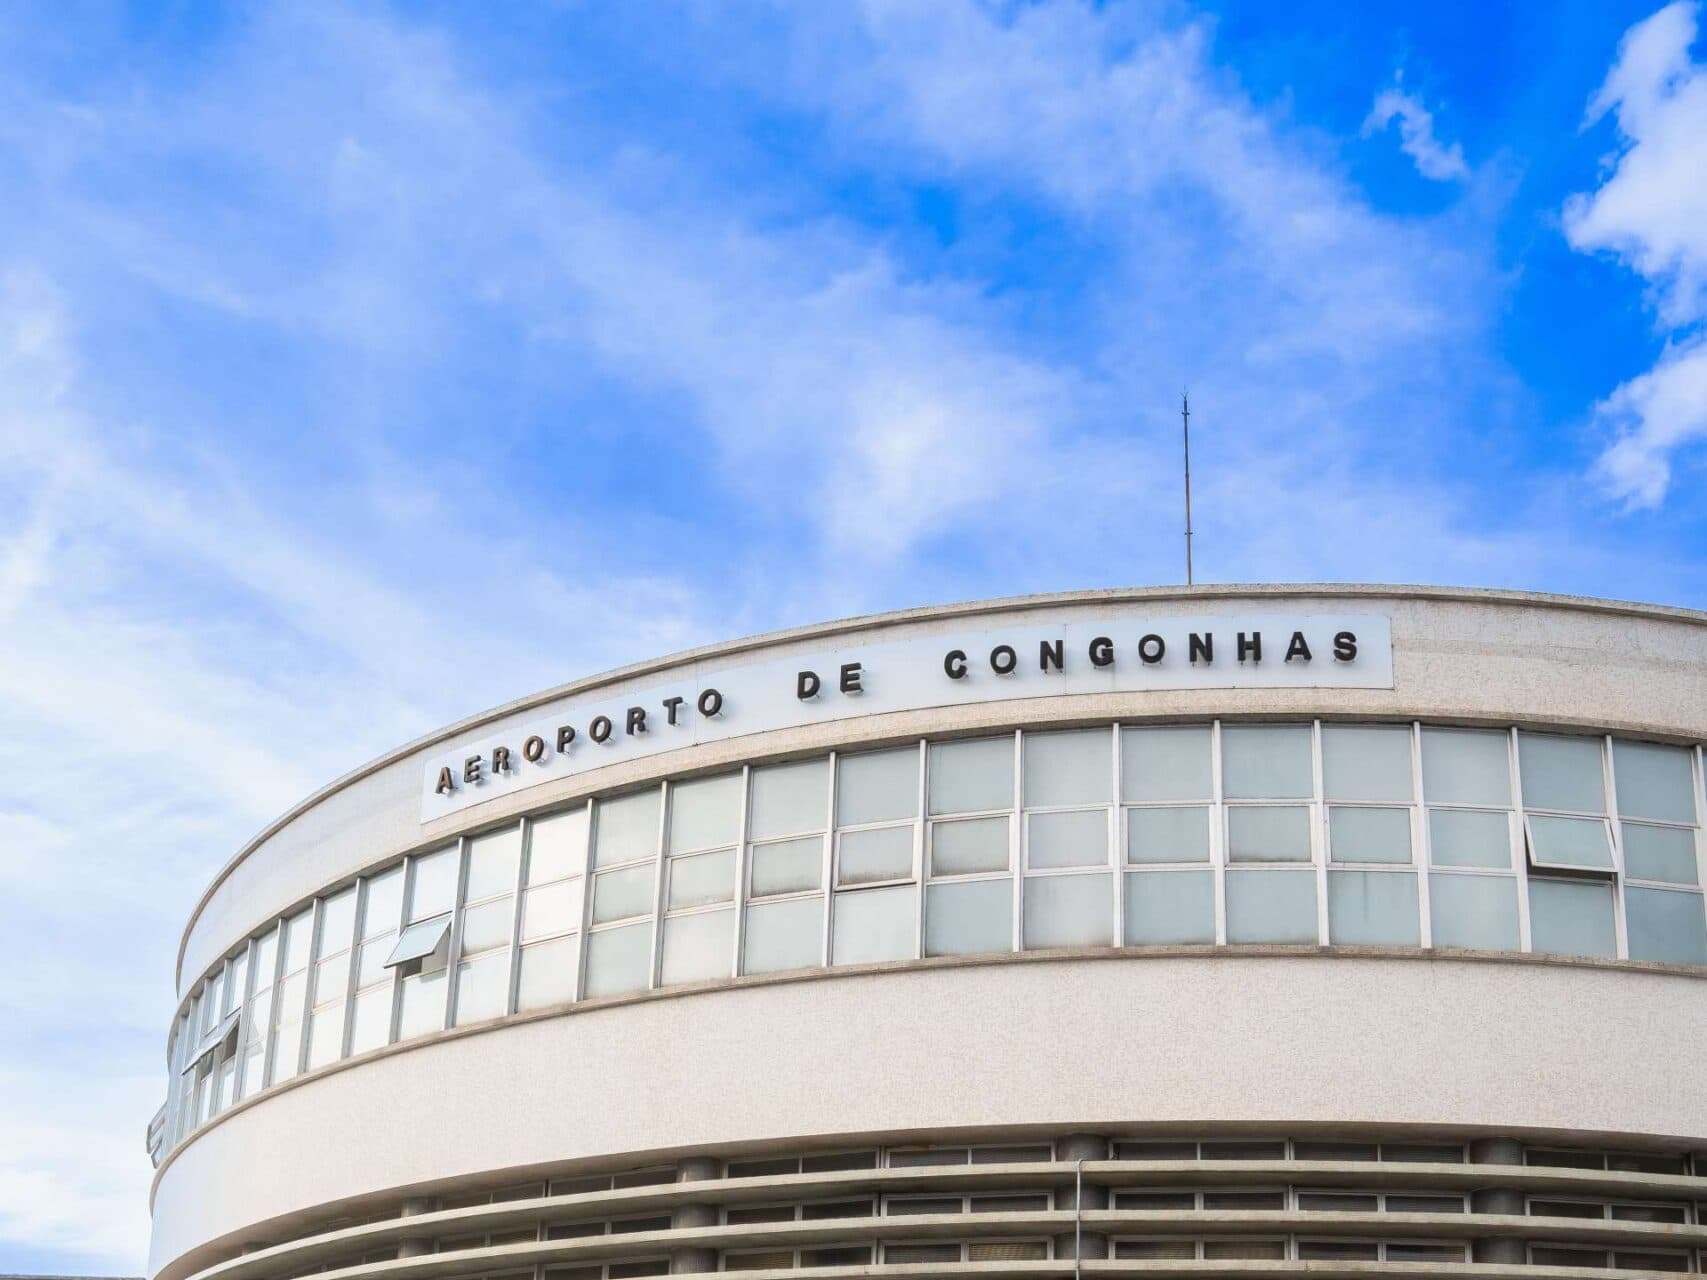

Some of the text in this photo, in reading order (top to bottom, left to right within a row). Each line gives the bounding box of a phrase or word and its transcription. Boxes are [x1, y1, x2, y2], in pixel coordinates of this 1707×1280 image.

[434, 630, 1359, 796] AEROPORTO DE CONGONHAS
